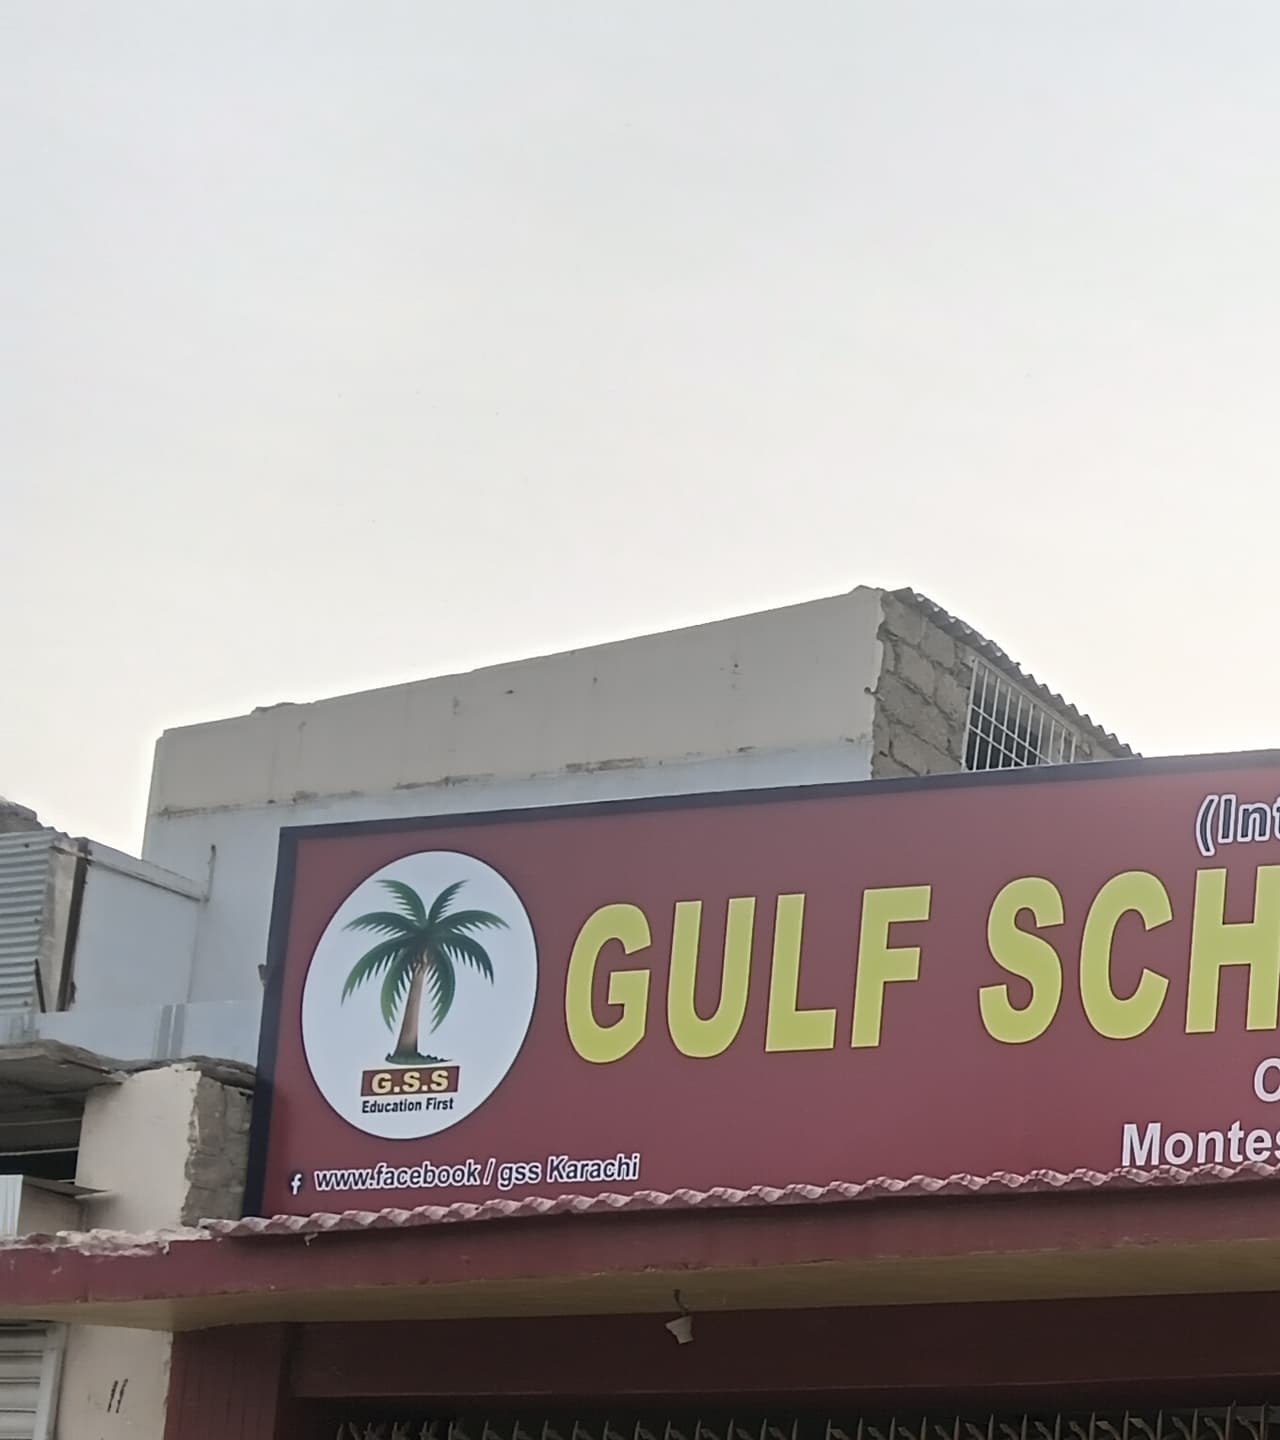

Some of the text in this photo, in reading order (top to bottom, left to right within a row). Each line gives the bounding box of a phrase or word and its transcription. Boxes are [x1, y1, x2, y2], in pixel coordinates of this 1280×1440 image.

[564, 884, 931, 1064] GULF
[371, 1070, 450, 1094] G.S.S
[362, 1096, 454, 1114] Education First
[314, 1162, 480, 1192] www.facebook
[499, 1162, 540, 1191] gss
[546, 1154, 640, 1183] Karachi
